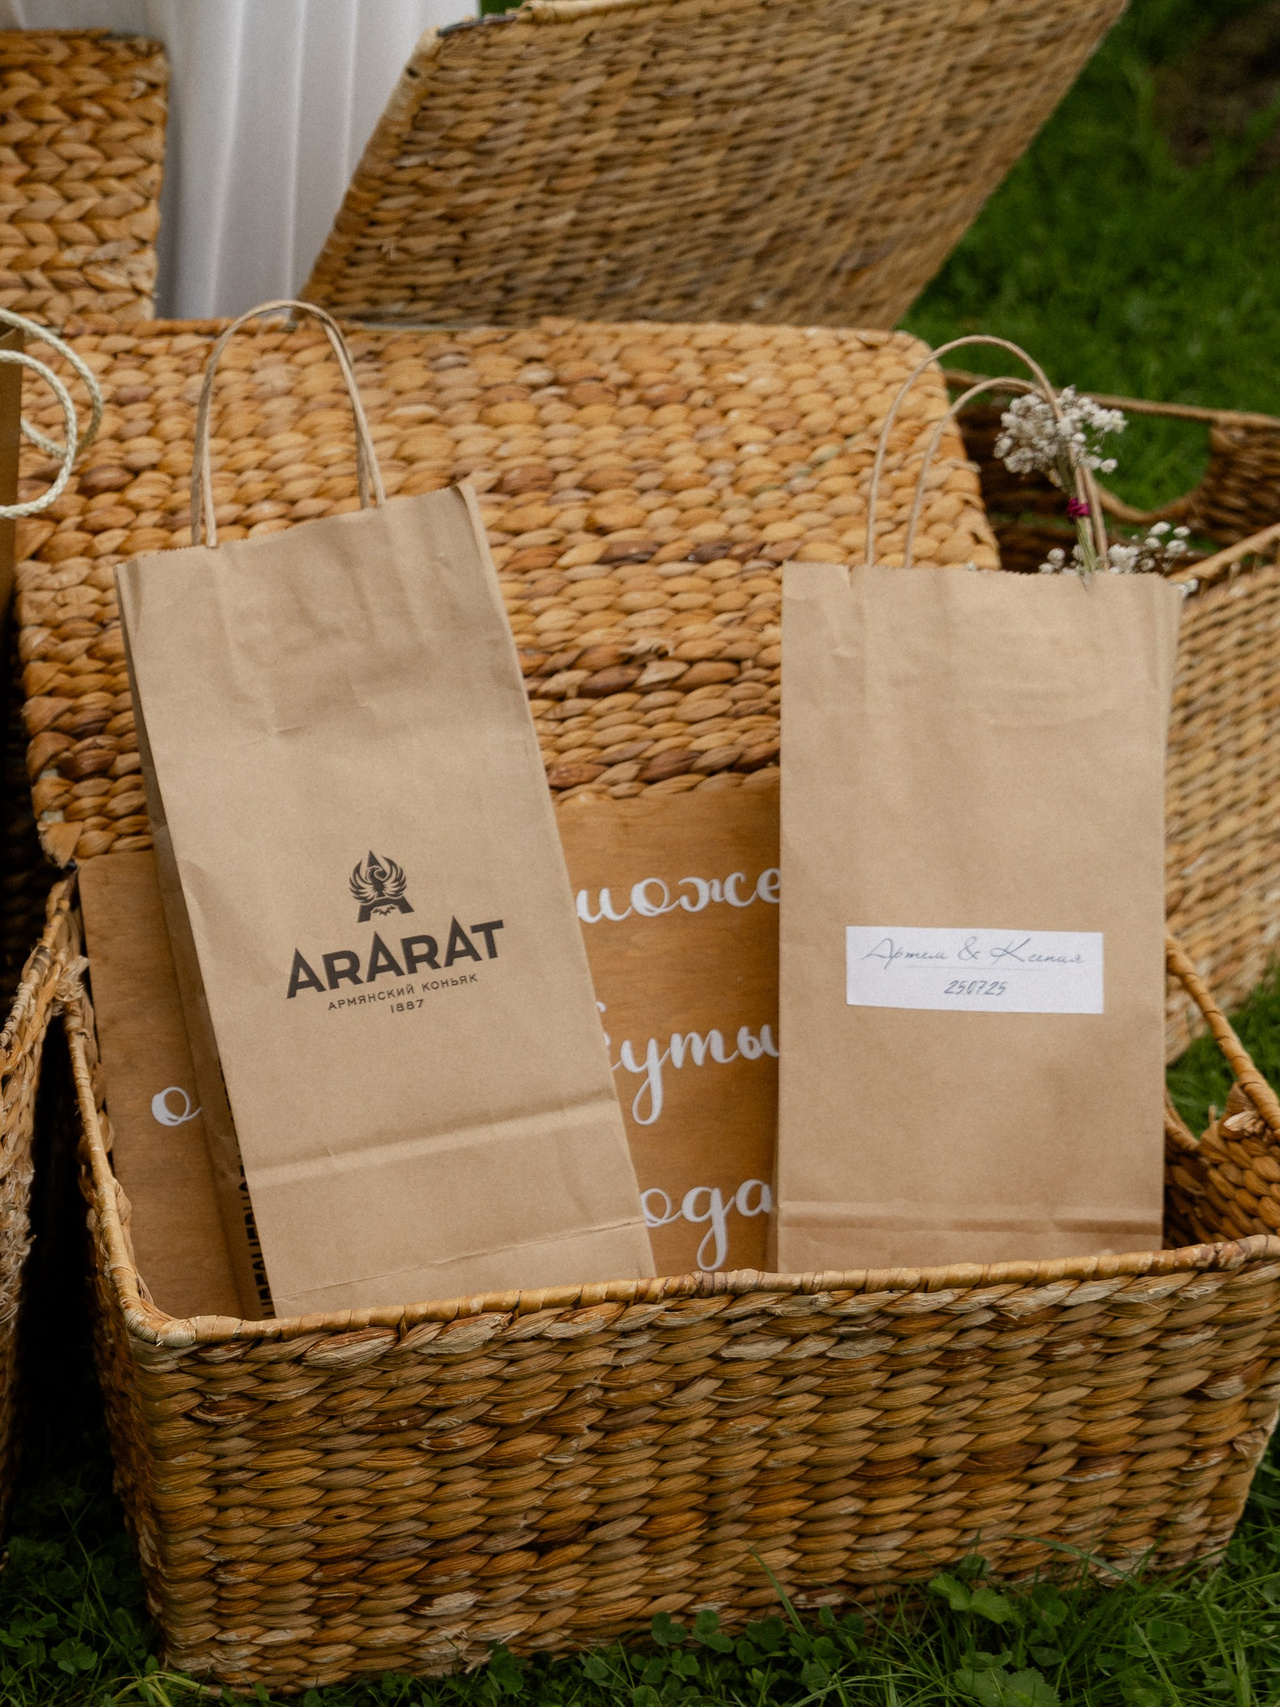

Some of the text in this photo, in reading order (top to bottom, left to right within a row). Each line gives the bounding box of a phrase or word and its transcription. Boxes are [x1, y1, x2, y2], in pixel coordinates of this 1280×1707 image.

[287, 915, 504, 999] ARARAT
[957, 936, 981, 961] &
[327, 973, 479, 1012] АРМЯНСКИЙ КОНЬЯК
[943, 980, 1009, 996] 250725
[390, 999, 424, 1013] 1887
